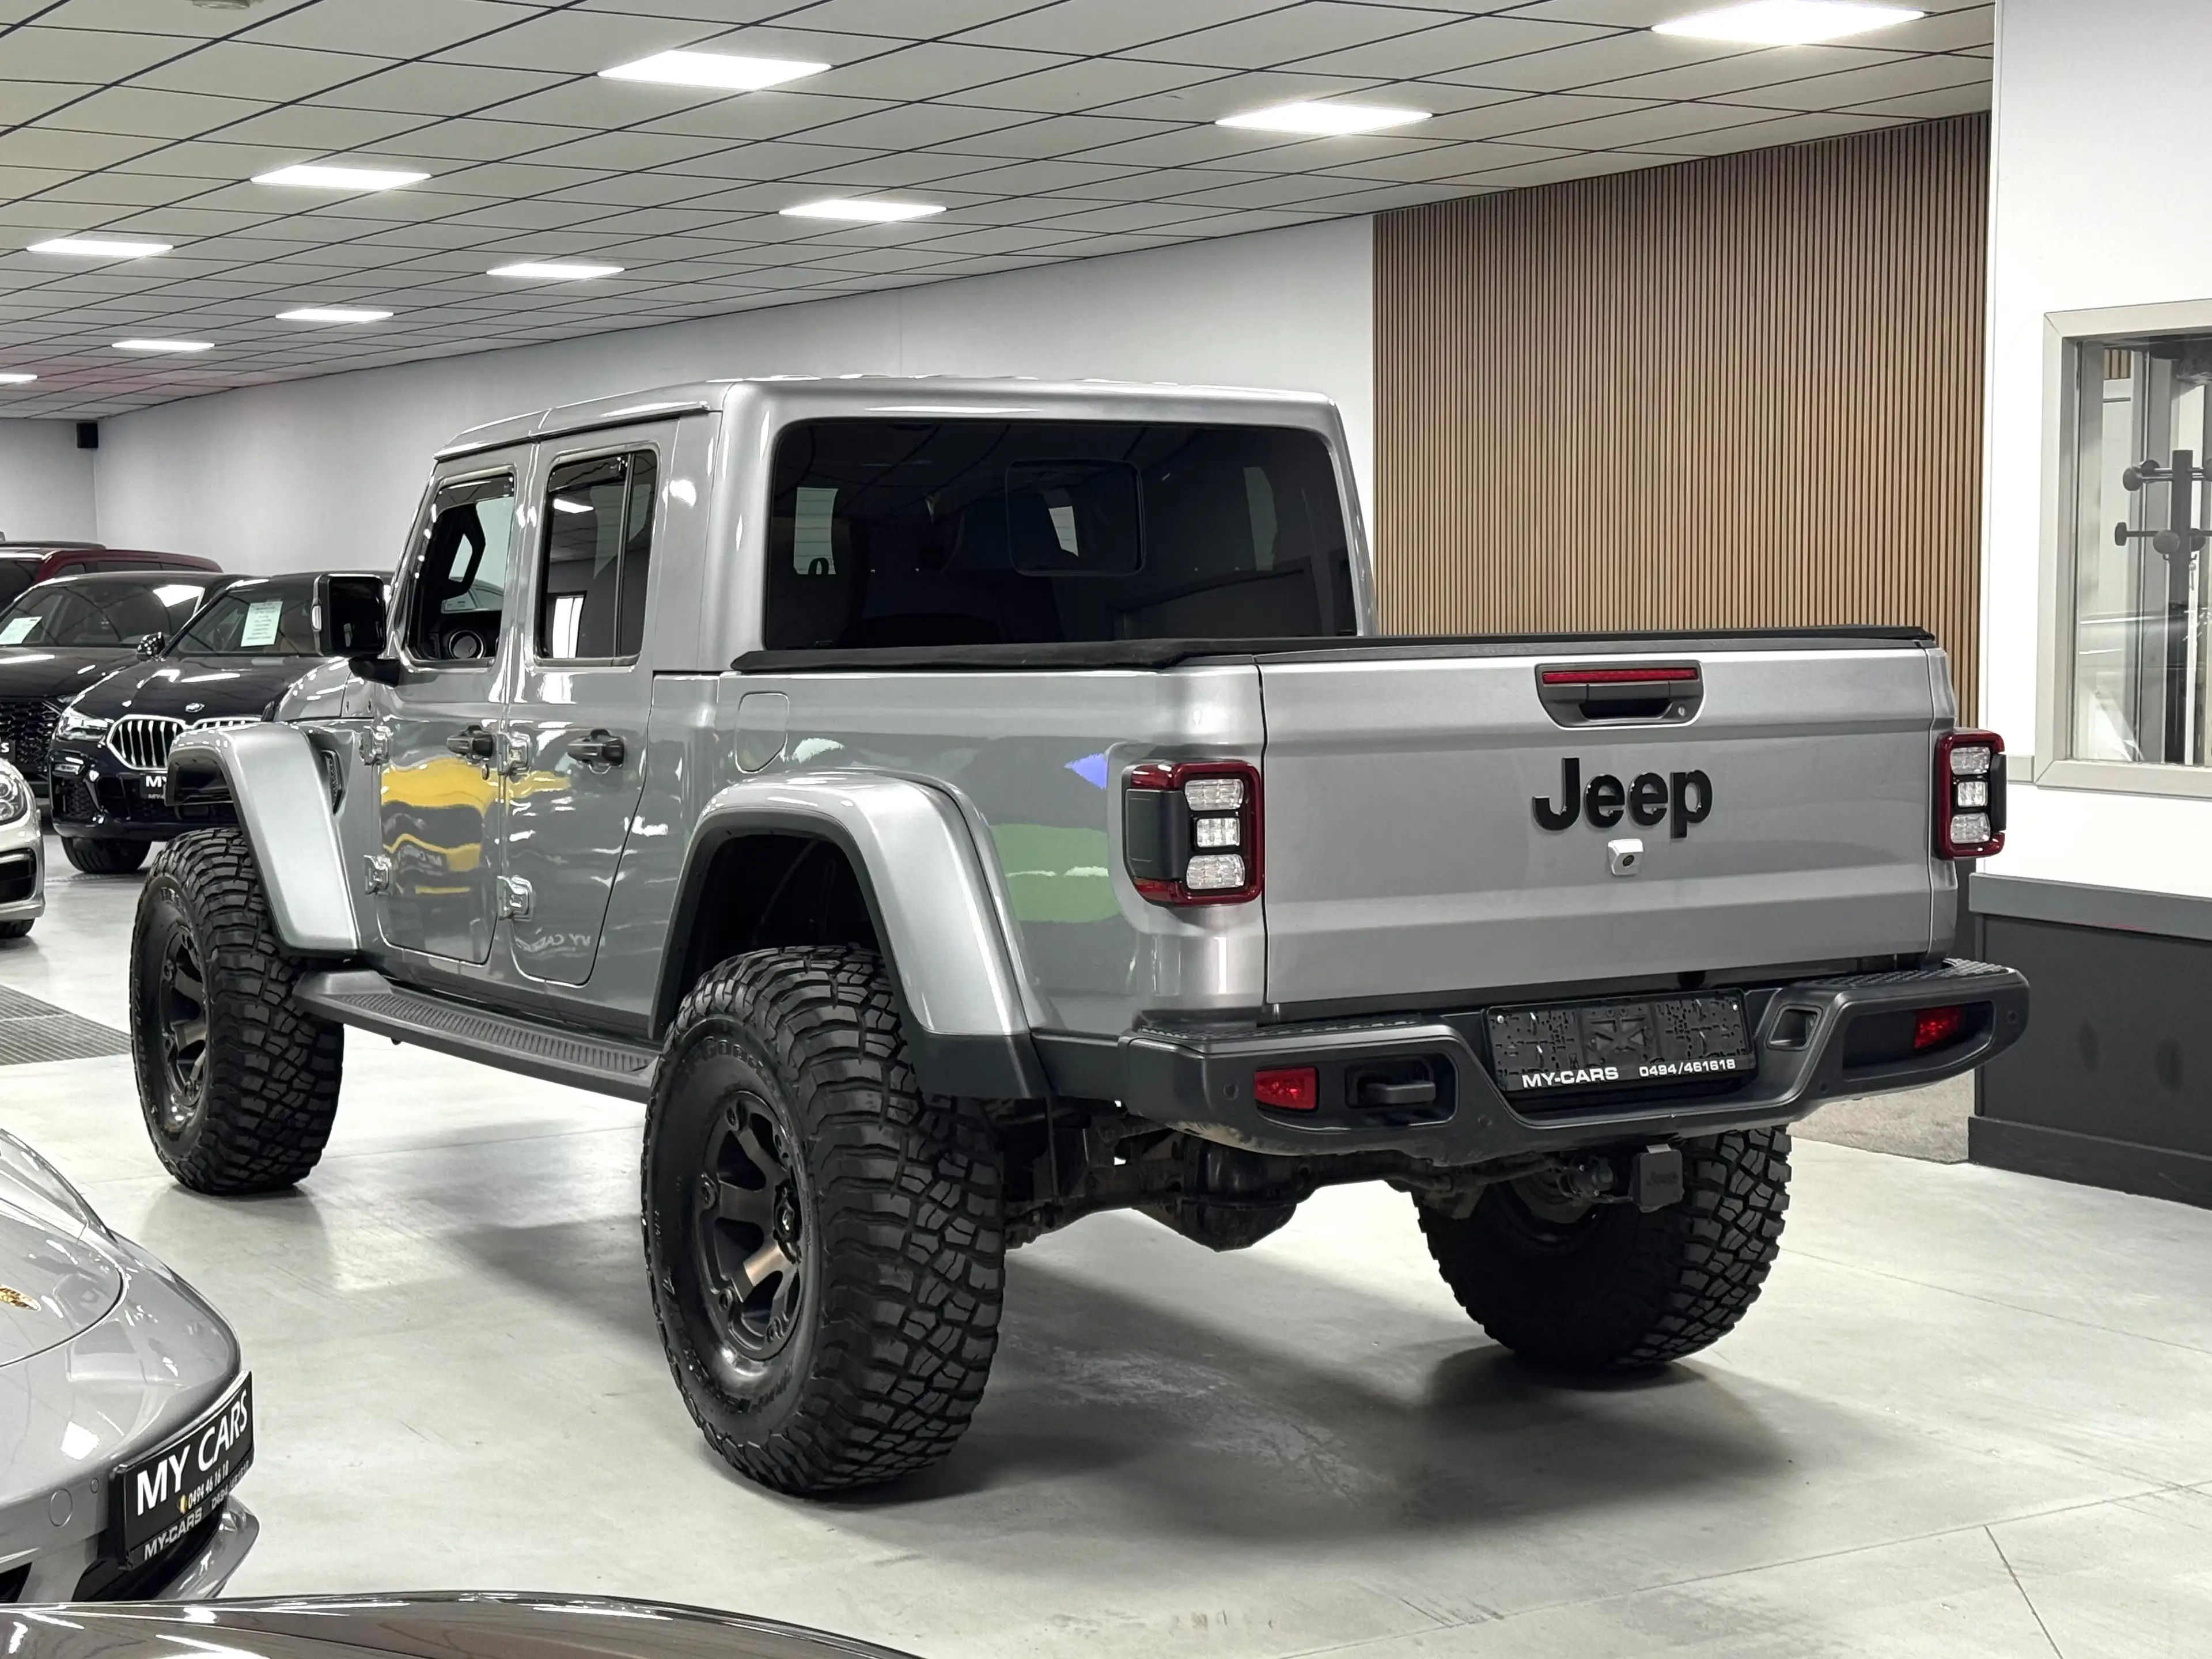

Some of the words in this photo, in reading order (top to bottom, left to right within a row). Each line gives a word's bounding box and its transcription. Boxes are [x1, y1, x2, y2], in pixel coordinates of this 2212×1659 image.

[1532, 756, 1713, 839] Jeep
[1521, 1066, 1619, 1088] MY-CARS
[1639, 1059, 1736, 1077] 0494/461618
[137, 1444, 191, 1516] MY
[198, 1388, 248, 1471] CARS
[144, 1506, 203, 1561] MY-CARS
